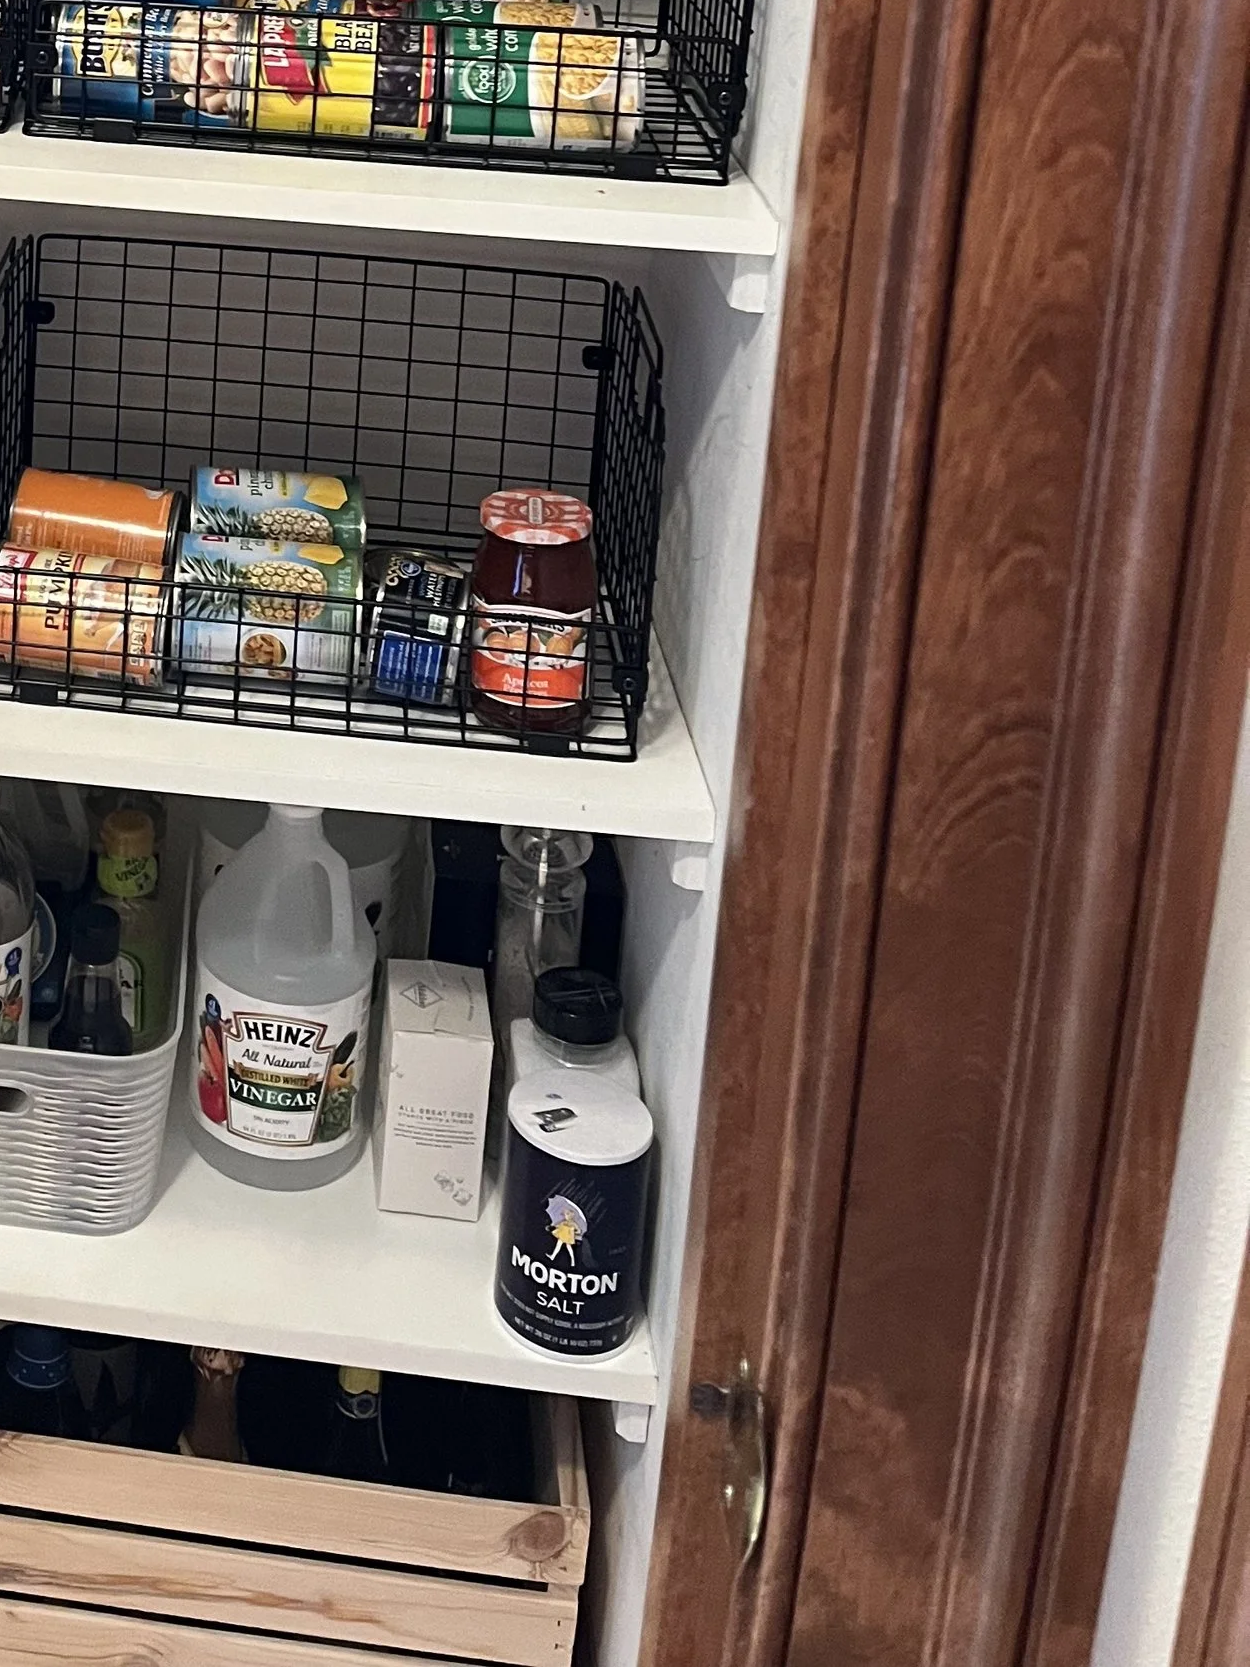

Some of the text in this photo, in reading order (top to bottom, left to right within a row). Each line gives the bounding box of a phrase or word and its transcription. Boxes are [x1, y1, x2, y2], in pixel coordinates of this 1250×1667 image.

[264, 47, 290, 68] LA
[475, 64, 490, 93] food
[243, 1020, 317, 1048] HEINZ
[241, 1048, 312, 1069] All Natural
[229, 1077, 317, 1107] VINEGAR
[282, 1076, 310, 1087] WHITE
[399, 1104, 415, 1114] ALL
[419, 1108, 448, 1117] GREAT
[511, 1245, 618, 1295] MORTON
[536, 1291, 585, 1315] SALT
